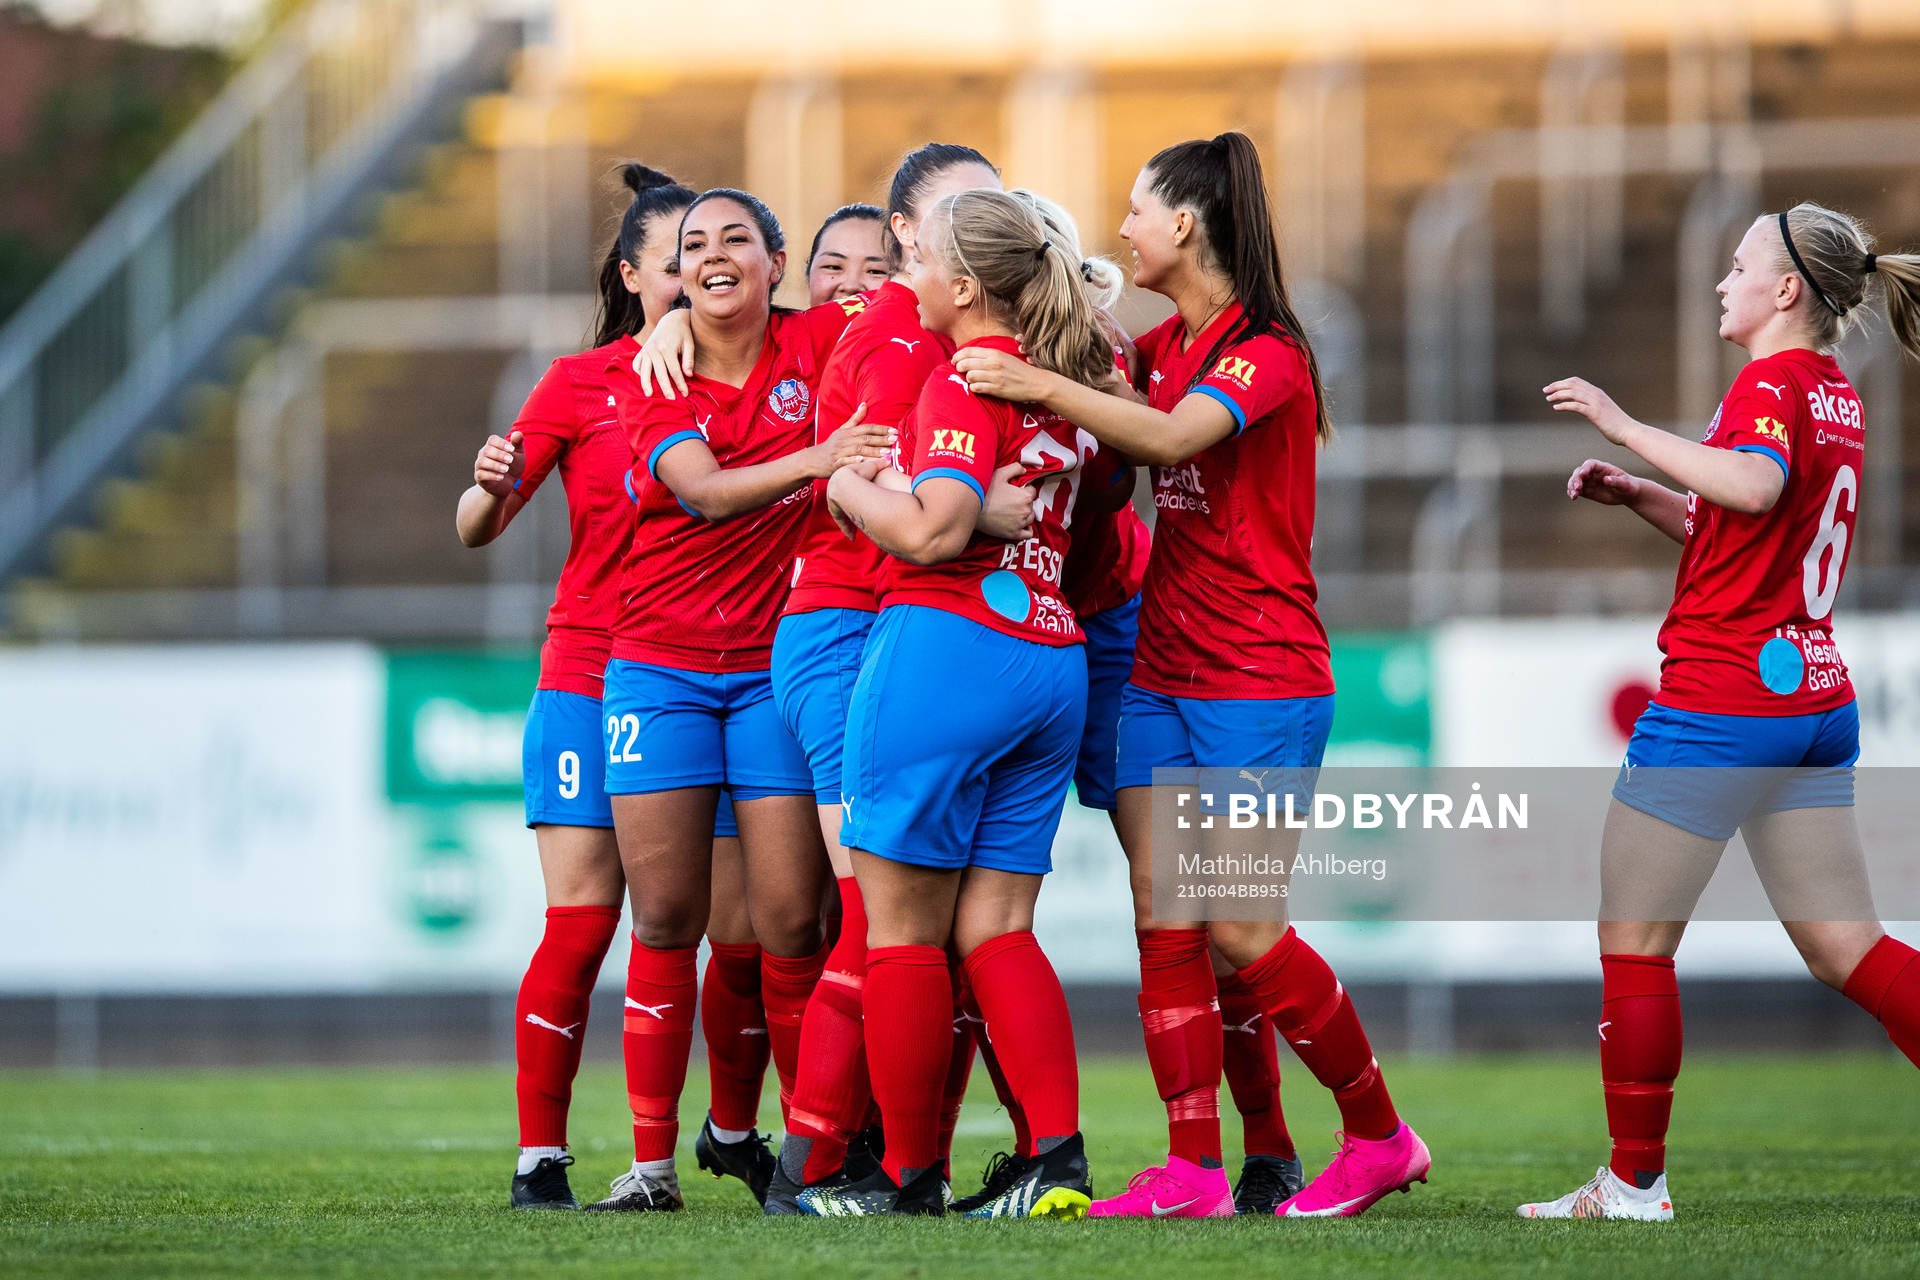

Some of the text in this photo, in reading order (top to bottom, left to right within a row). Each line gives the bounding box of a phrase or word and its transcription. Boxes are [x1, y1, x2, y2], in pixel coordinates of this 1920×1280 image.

[1213, 356, 1257, 387] XXL
[929, 429, 976, 458] XXL
[956, 453, 975, 464] UNITED
[1802, 465, 1857, 620] 6
[607, 713, 643, 763] 22
[558, 750, 580, 800] 9
